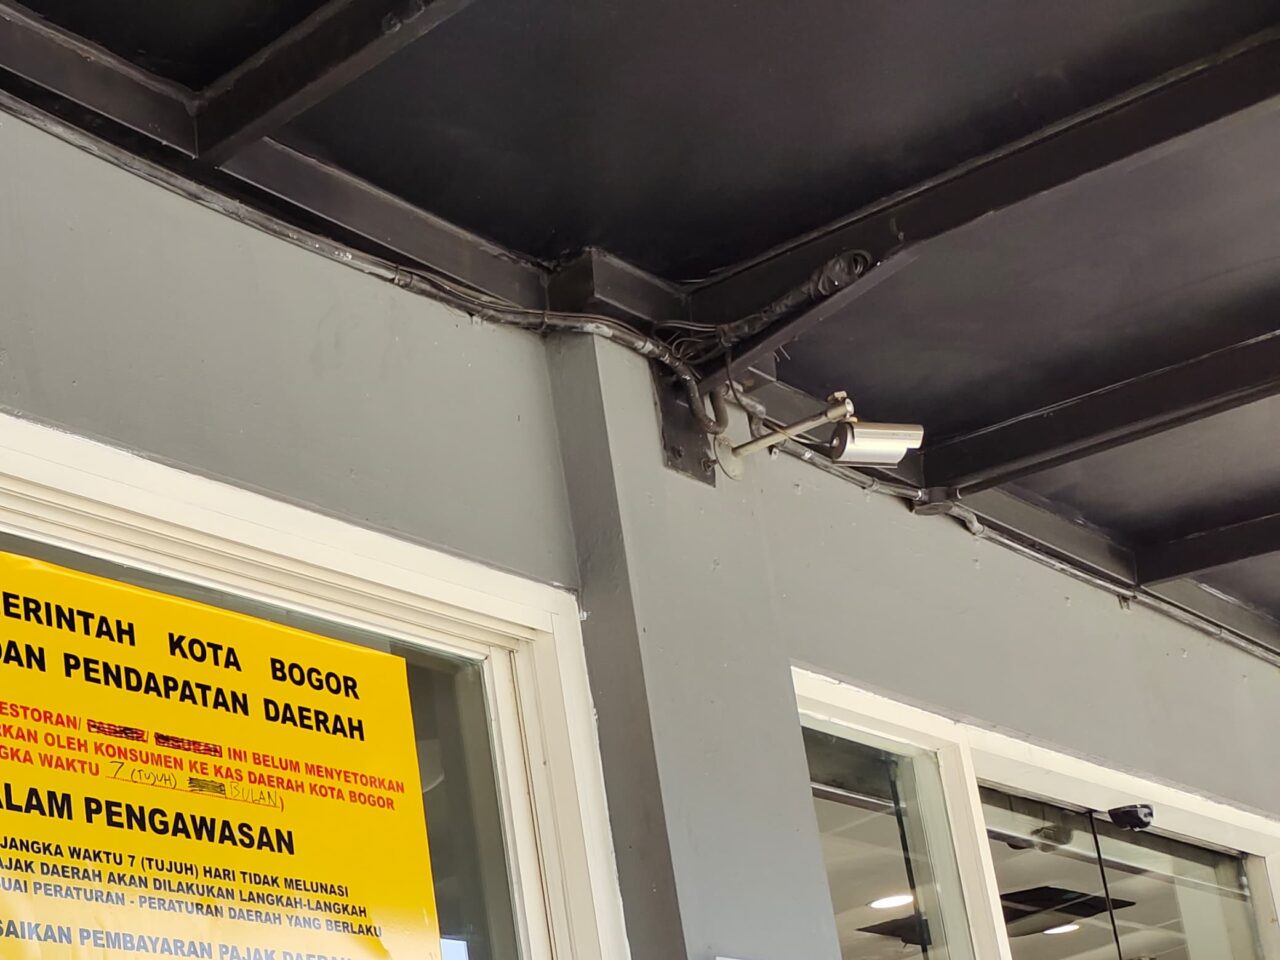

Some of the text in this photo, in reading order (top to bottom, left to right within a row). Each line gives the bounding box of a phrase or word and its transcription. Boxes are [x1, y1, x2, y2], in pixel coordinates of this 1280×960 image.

[168, 632, 241, 671] KOTA
[270, 657, 359, 699] BOGOR
[63, 652, 248, 715] PENDAPATAN
[263, 698, 364, 740] DAERAH
[38, 752, 99, 776] WAKTU
[43, 731, 88, 753] OLEH
[93, 741, 183, 771] KONSUMEN
[188, 759, 209, 776] KE
[213, 764, 243, 782] KAS
[247, 770, 304, 793] DAERAH
[308, 782, 345, 800] KOTA
[348, 790, 394, 810] BOGOR
[227, 747, 247, 762] INI
[251, 752, 300, 773] BELUM
[304, 762, 404, 792] MENYETORKAN
[84, 797, 294, 854] PENGAWASAN
[0, 836, 63, 857] JANGKA
[67, 845, 122, 865] WAKTU
[141, 857, 198, 879] (TUJUH)
[202, 865, 235, 881] HARI
[239, 870, 279, 887] TIDAK
[283, 877, 348, 897] MELUNASI
[40, 861, 102, 882] DAERAH
[107, 871, 148, 888] AKAN
[152, 877, 234, 899] DILAKUKAN
[239, 889, 366, 917] LANGKAH-LANGKAH
[33, 881, 124, 905] PERATURAN
[138, 895, 223, 917] PERATURAN
[228, 906, 281, 924] DAERAH
[285, 913, 321, 929] YANG
[325, 919, 383, 937] BERLAKU
[78, 928, 212, 959] PEMBAYARAN
